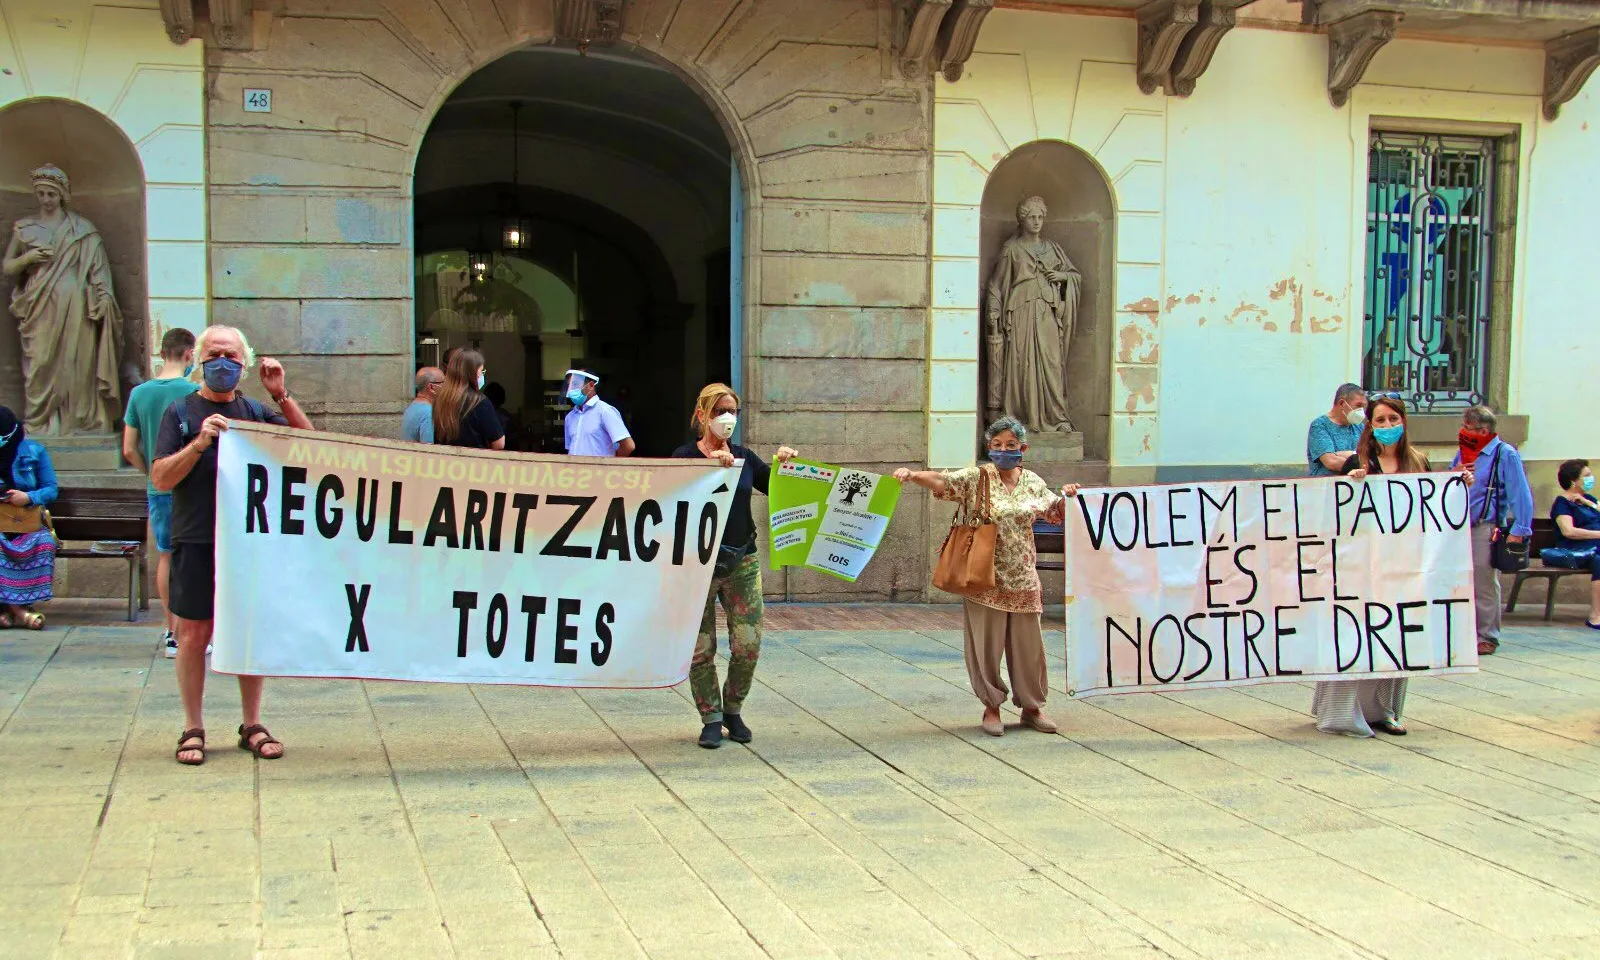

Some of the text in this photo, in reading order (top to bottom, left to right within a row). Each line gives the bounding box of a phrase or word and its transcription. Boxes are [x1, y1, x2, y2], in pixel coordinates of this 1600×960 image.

[249, 93, 267, 107] 48
[246, 463, 729, 566] REGULARITZACIÓ
[1077, 486, 1237, 551] VOLEM
[1262, 483, 1318, 541] EL
[828, 553, 850, 567] tots
[1205, 533, 1359, 608] ÉS EL
[344, 584, 615, 667] X TOTES
[1106, 598, 1470, 688] NOSTRE DRET
